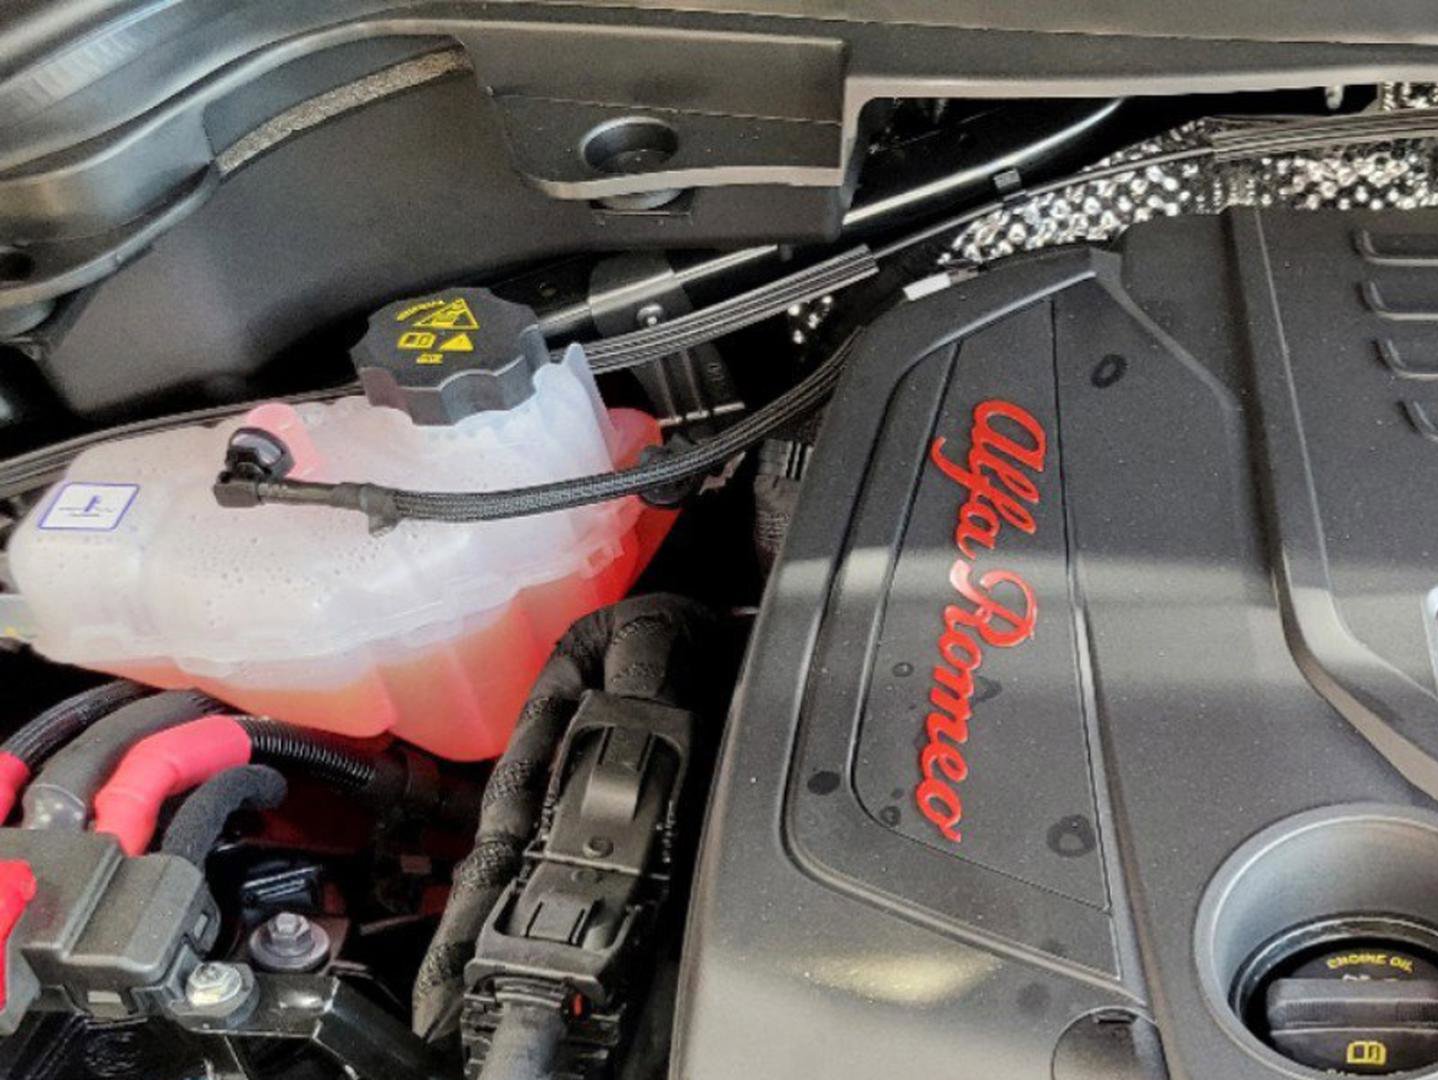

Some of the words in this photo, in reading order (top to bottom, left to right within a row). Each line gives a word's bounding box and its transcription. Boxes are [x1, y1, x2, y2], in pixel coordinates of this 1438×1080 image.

[930, 398, 1047, 560] Alfa
[916, 559, 1039, 843] Romeo
[1327, 953, 1387, 969] ENGINE
[1390, 956, 1413, 973] OIL
